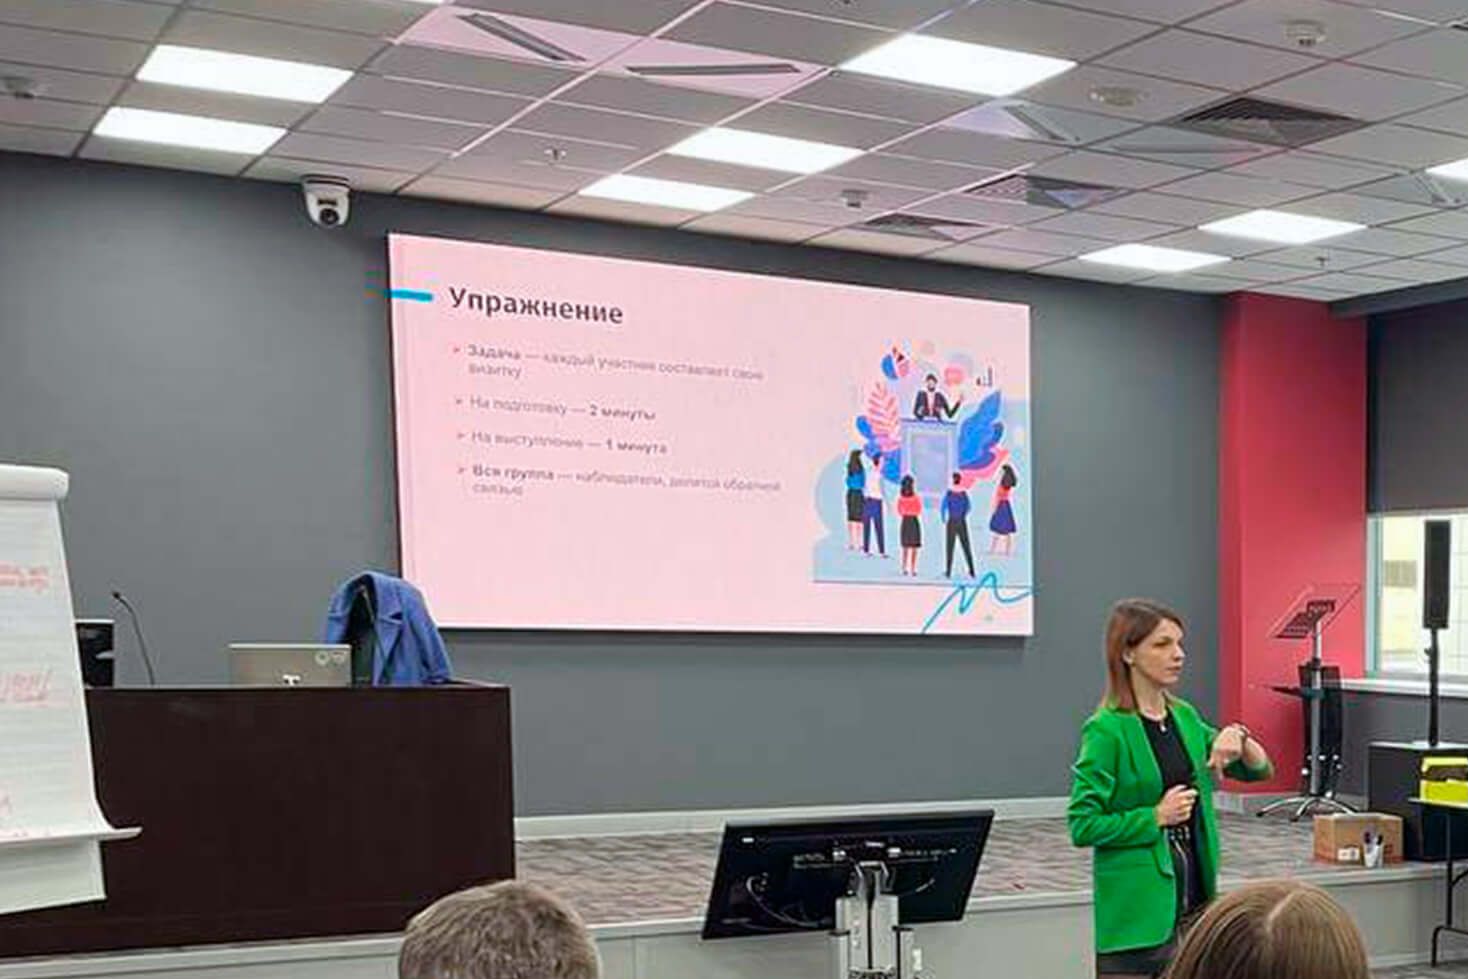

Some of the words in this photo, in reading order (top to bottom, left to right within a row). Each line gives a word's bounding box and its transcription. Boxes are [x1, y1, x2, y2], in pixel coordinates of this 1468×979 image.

[449, 286, 624, 324] Упражнение
[468, 344, 521, 361] Задача
[589, 403, 598, 417] 2
[601, 407, 656, 422] минуты
[605, 439, 613, 450] 1
[617, 441, 668, 455] минута
[472, 464, 501, 478] Вся
[504, 468, 554, 482] группа
